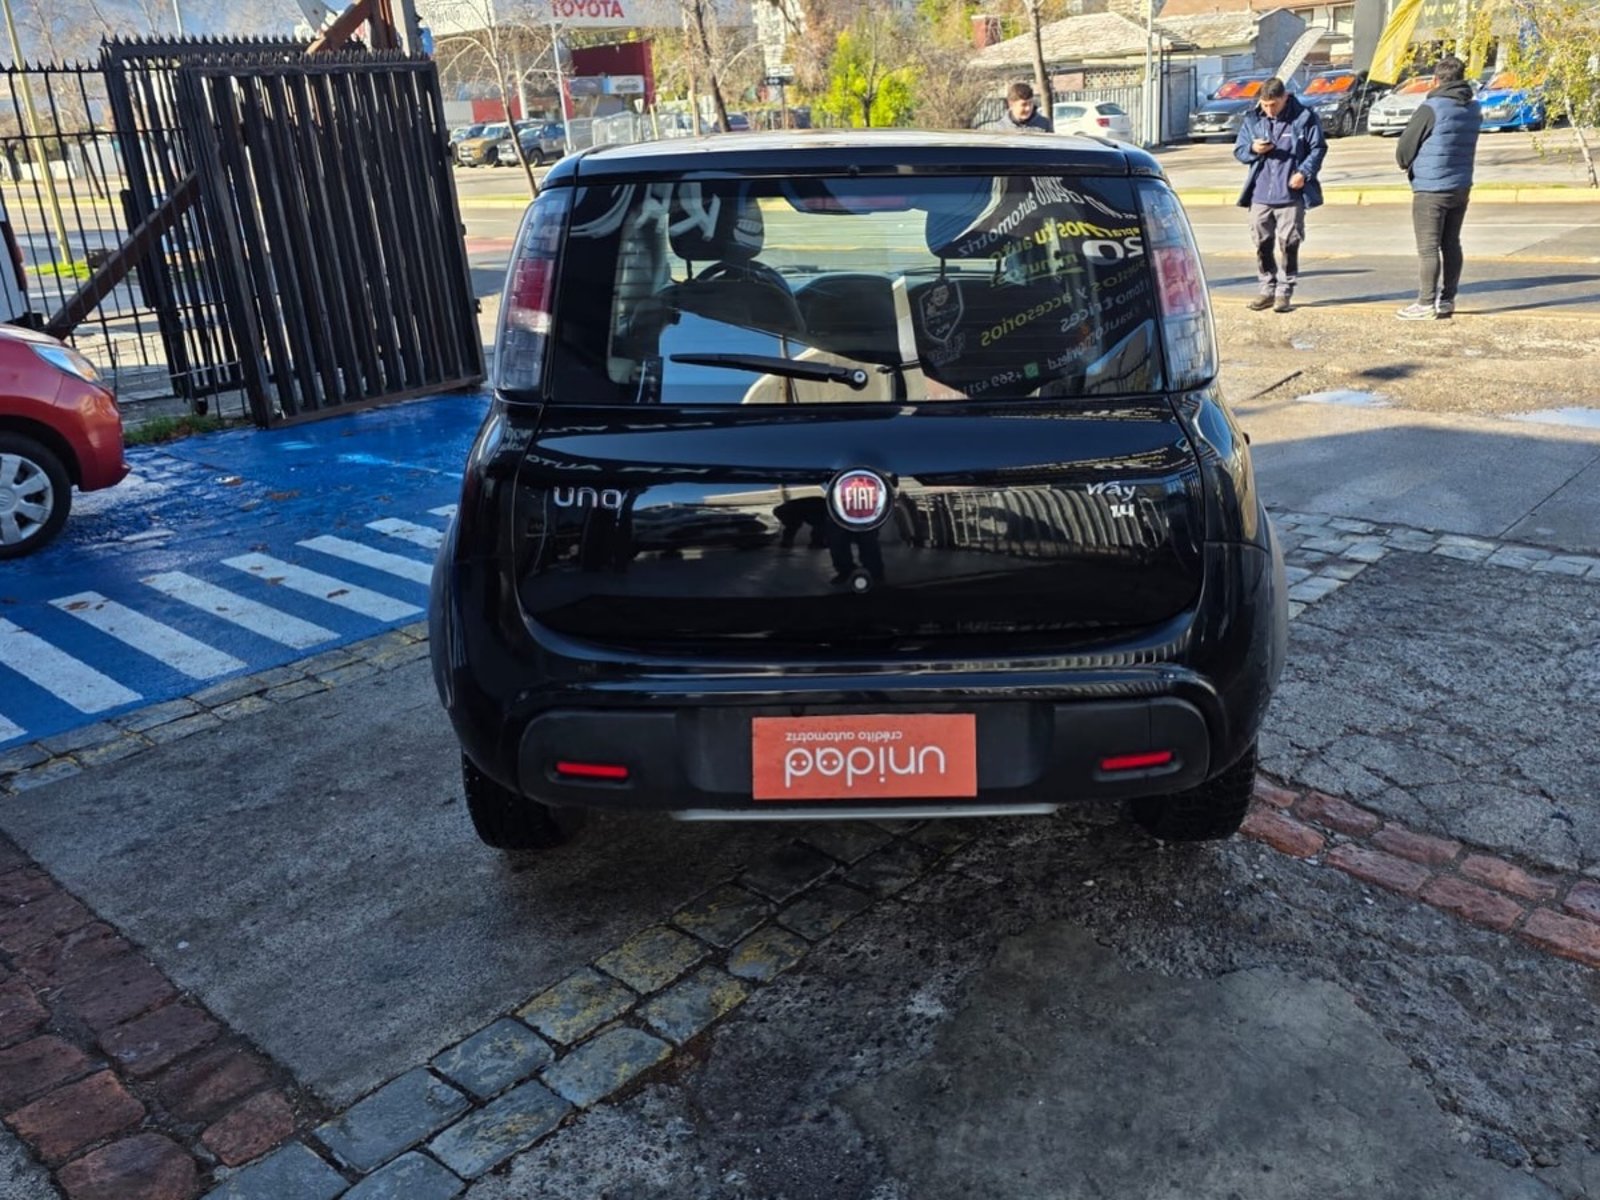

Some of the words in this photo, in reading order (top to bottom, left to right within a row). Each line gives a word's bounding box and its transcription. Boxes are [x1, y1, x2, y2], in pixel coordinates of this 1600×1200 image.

[551, 0, 624, 18] TOYOTA
[553, 486, 623, 509] uno
[845, 487, 875, 511] FIAT
[1110, 503, 1135, 518] 1.4
[786, 731, 856, 744] automotriz
[858, 731, 904, 744] crédito
[785, 746, 946, 788] unidad
